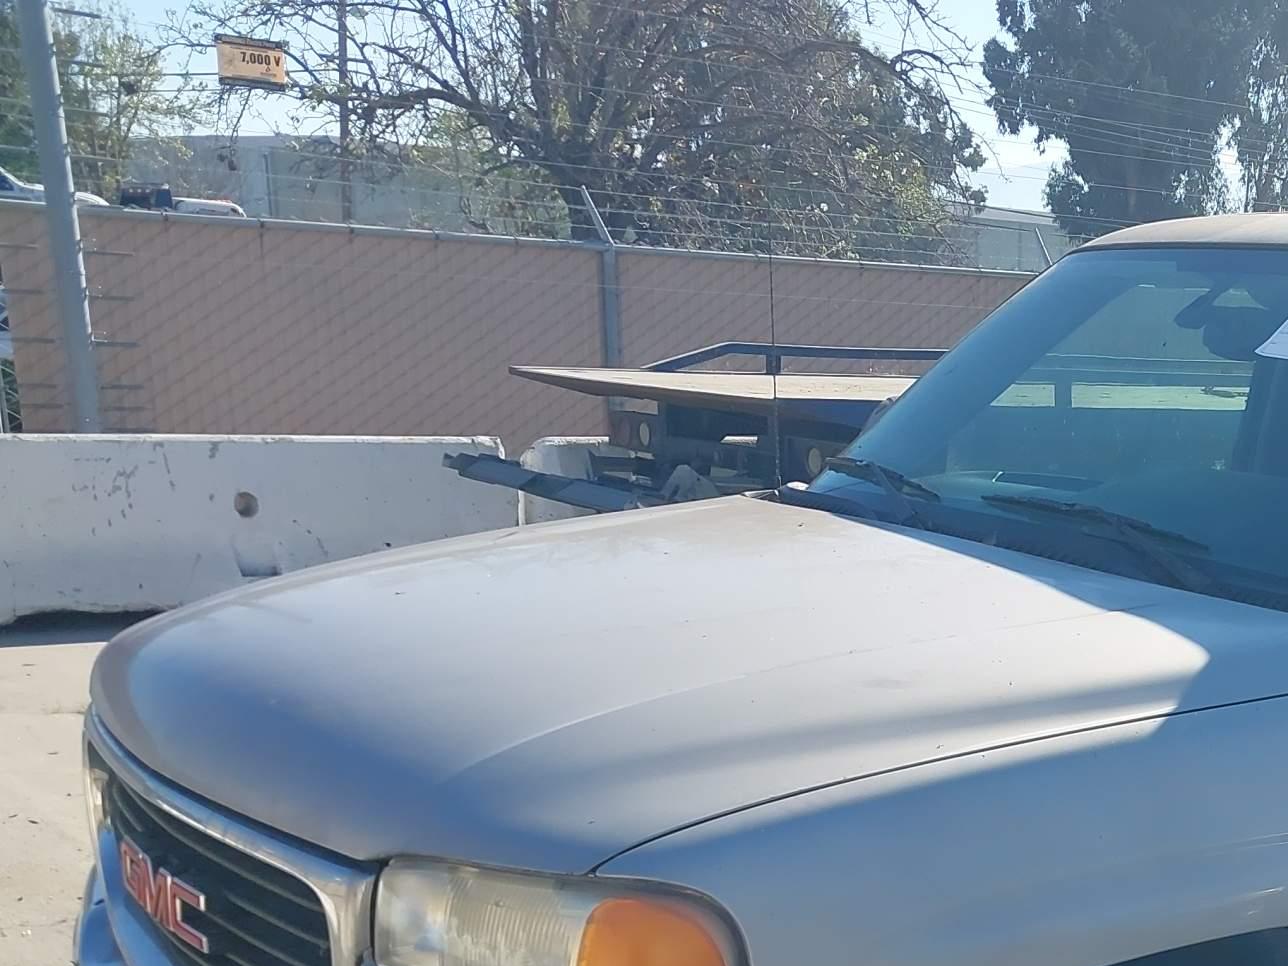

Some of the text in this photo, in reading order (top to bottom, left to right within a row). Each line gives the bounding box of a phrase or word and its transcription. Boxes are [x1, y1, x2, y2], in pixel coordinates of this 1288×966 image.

[240, 51, 281, 67] 7,000 V
[120, 835, 209, 954] GMC
